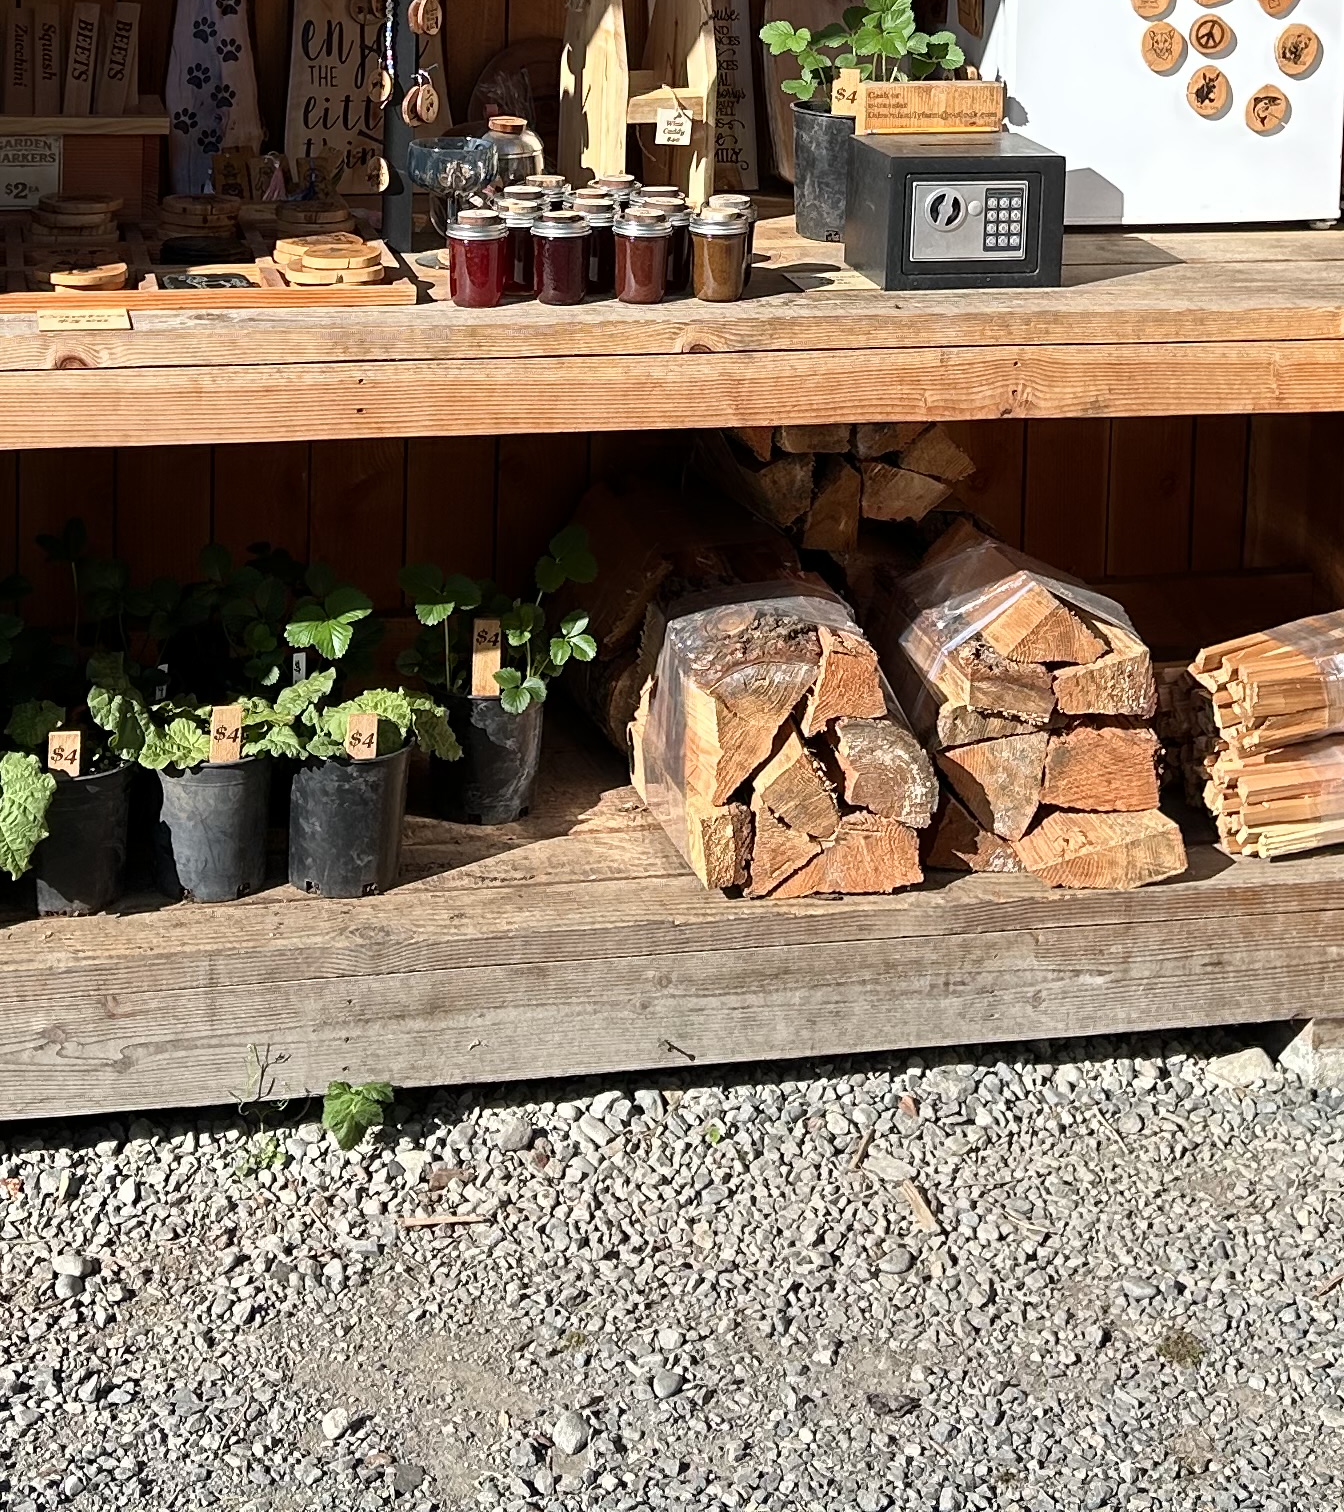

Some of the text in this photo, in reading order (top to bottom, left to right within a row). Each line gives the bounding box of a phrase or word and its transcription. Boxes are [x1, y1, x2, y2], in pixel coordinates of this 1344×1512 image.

[13, 23, 29, 88] Zucchini
[38, 22, 57, 82] Squash
[71, 18, 95, 83] BEETS
[107, 19, 133, 82] BEETS
[308, 65, 339, 87] THE
[834, 87, 858, 105] $4
[4, 181, 28, 200] $2
[476, 628, 500, 647] $4
[213, 724, 240, 744] $4
[348, 730, 375, 749] $4
[50, 745, 78, 766] $4
